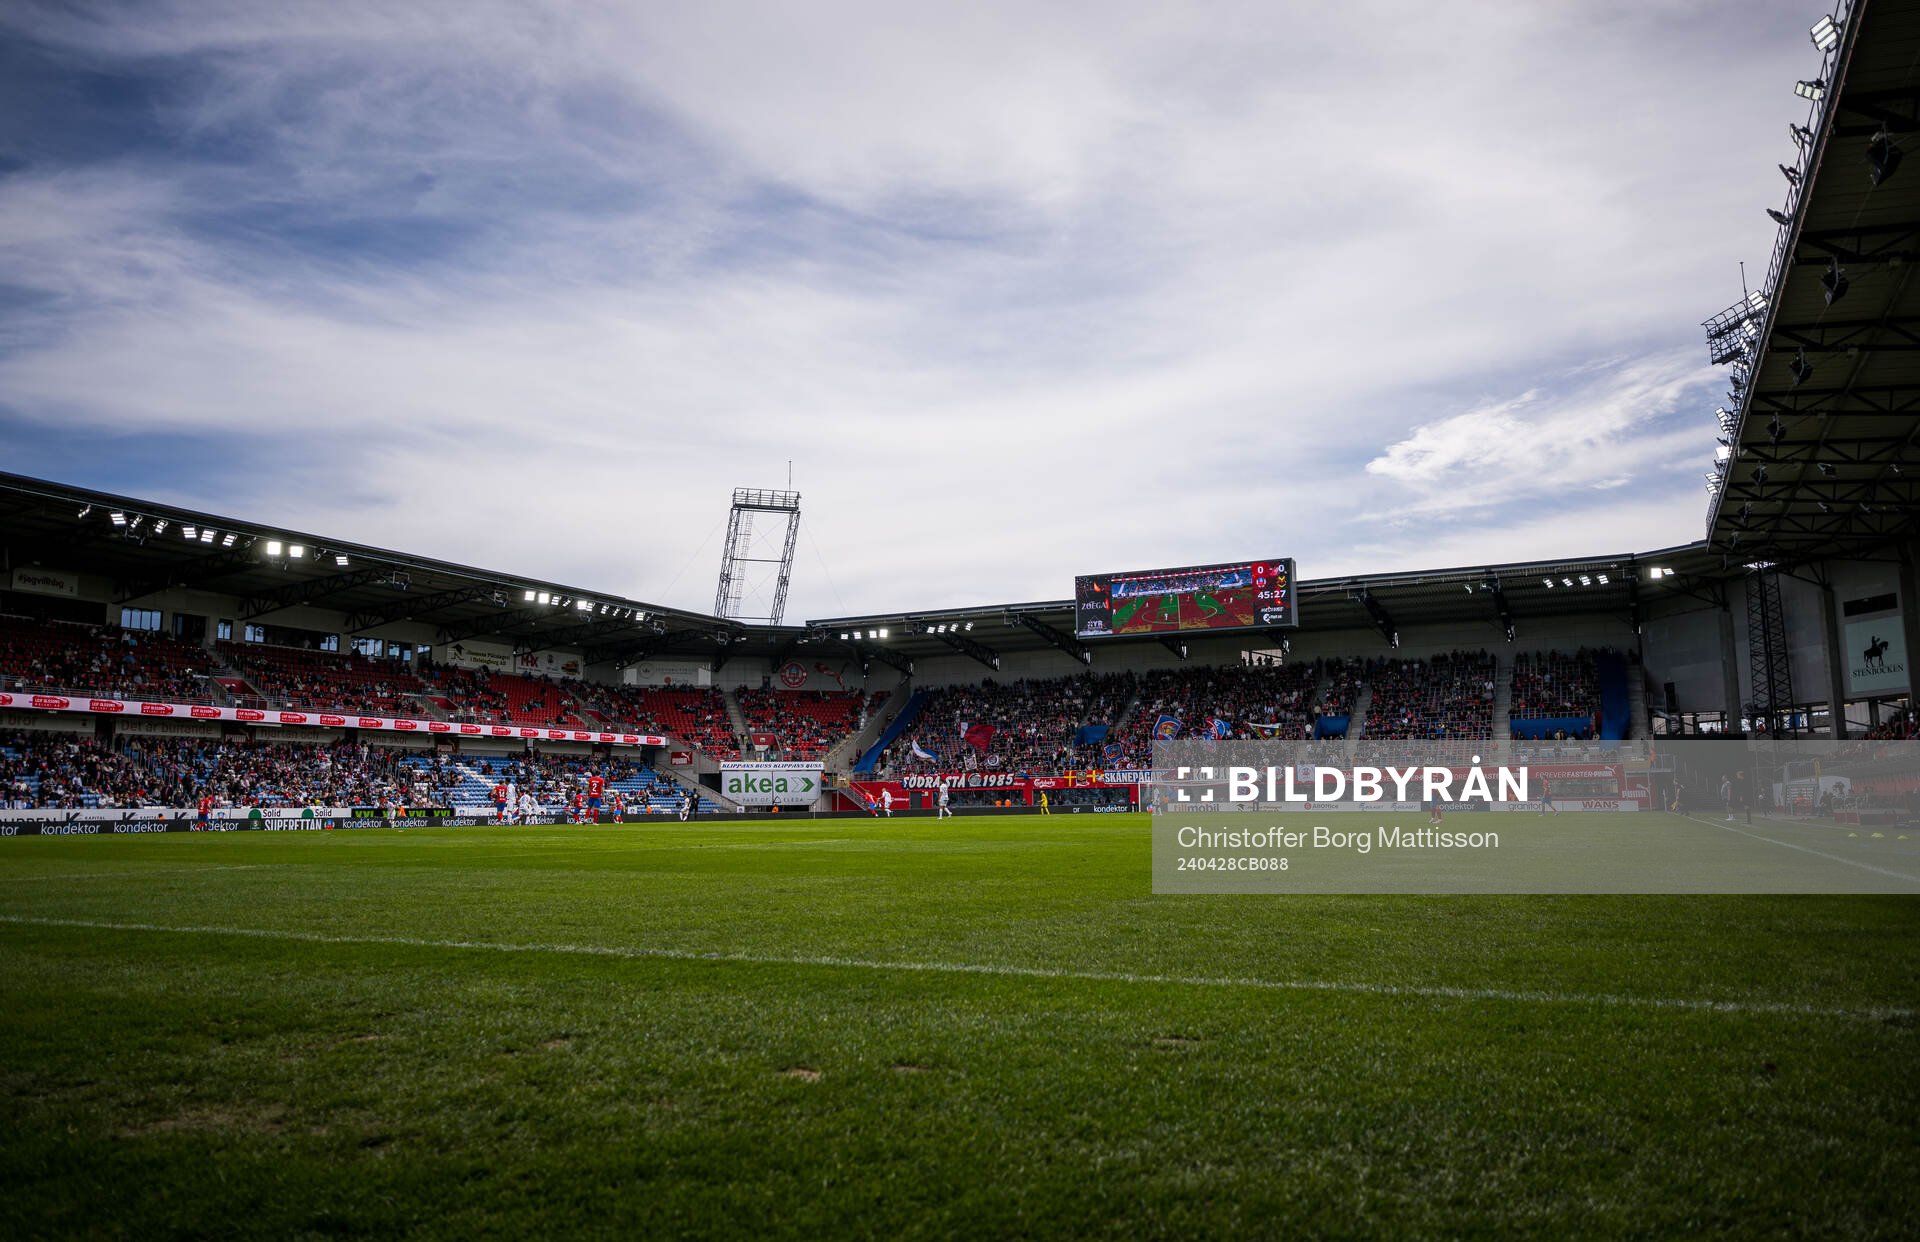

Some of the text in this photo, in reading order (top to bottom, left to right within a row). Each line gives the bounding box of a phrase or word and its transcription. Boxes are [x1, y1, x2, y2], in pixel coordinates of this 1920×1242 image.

[1257, 564, 1285, 574] 0 0
[1257, 589, 1286, 600] 45:27
[1852, 664, 1904, 678] STENBOCKEN
[728, 773, 788, 793] akea
[982, 773, 1015, 787] 1985
[1033, 778, 1056, 788] Carlsberg
[592, 783, 597, 792] 2
[1093, 805, 1128, 813] kondektor
[1439, 803, 1475, 811] ondektor
[113, 821, 168, 833] kondektor
[264, 819, 322, 831] SUPERETTAN
[342, 818, 382, 828] kondektor
[442, 817, 477, 827] kondektor
[41, 822, 101, 835] kondektor
